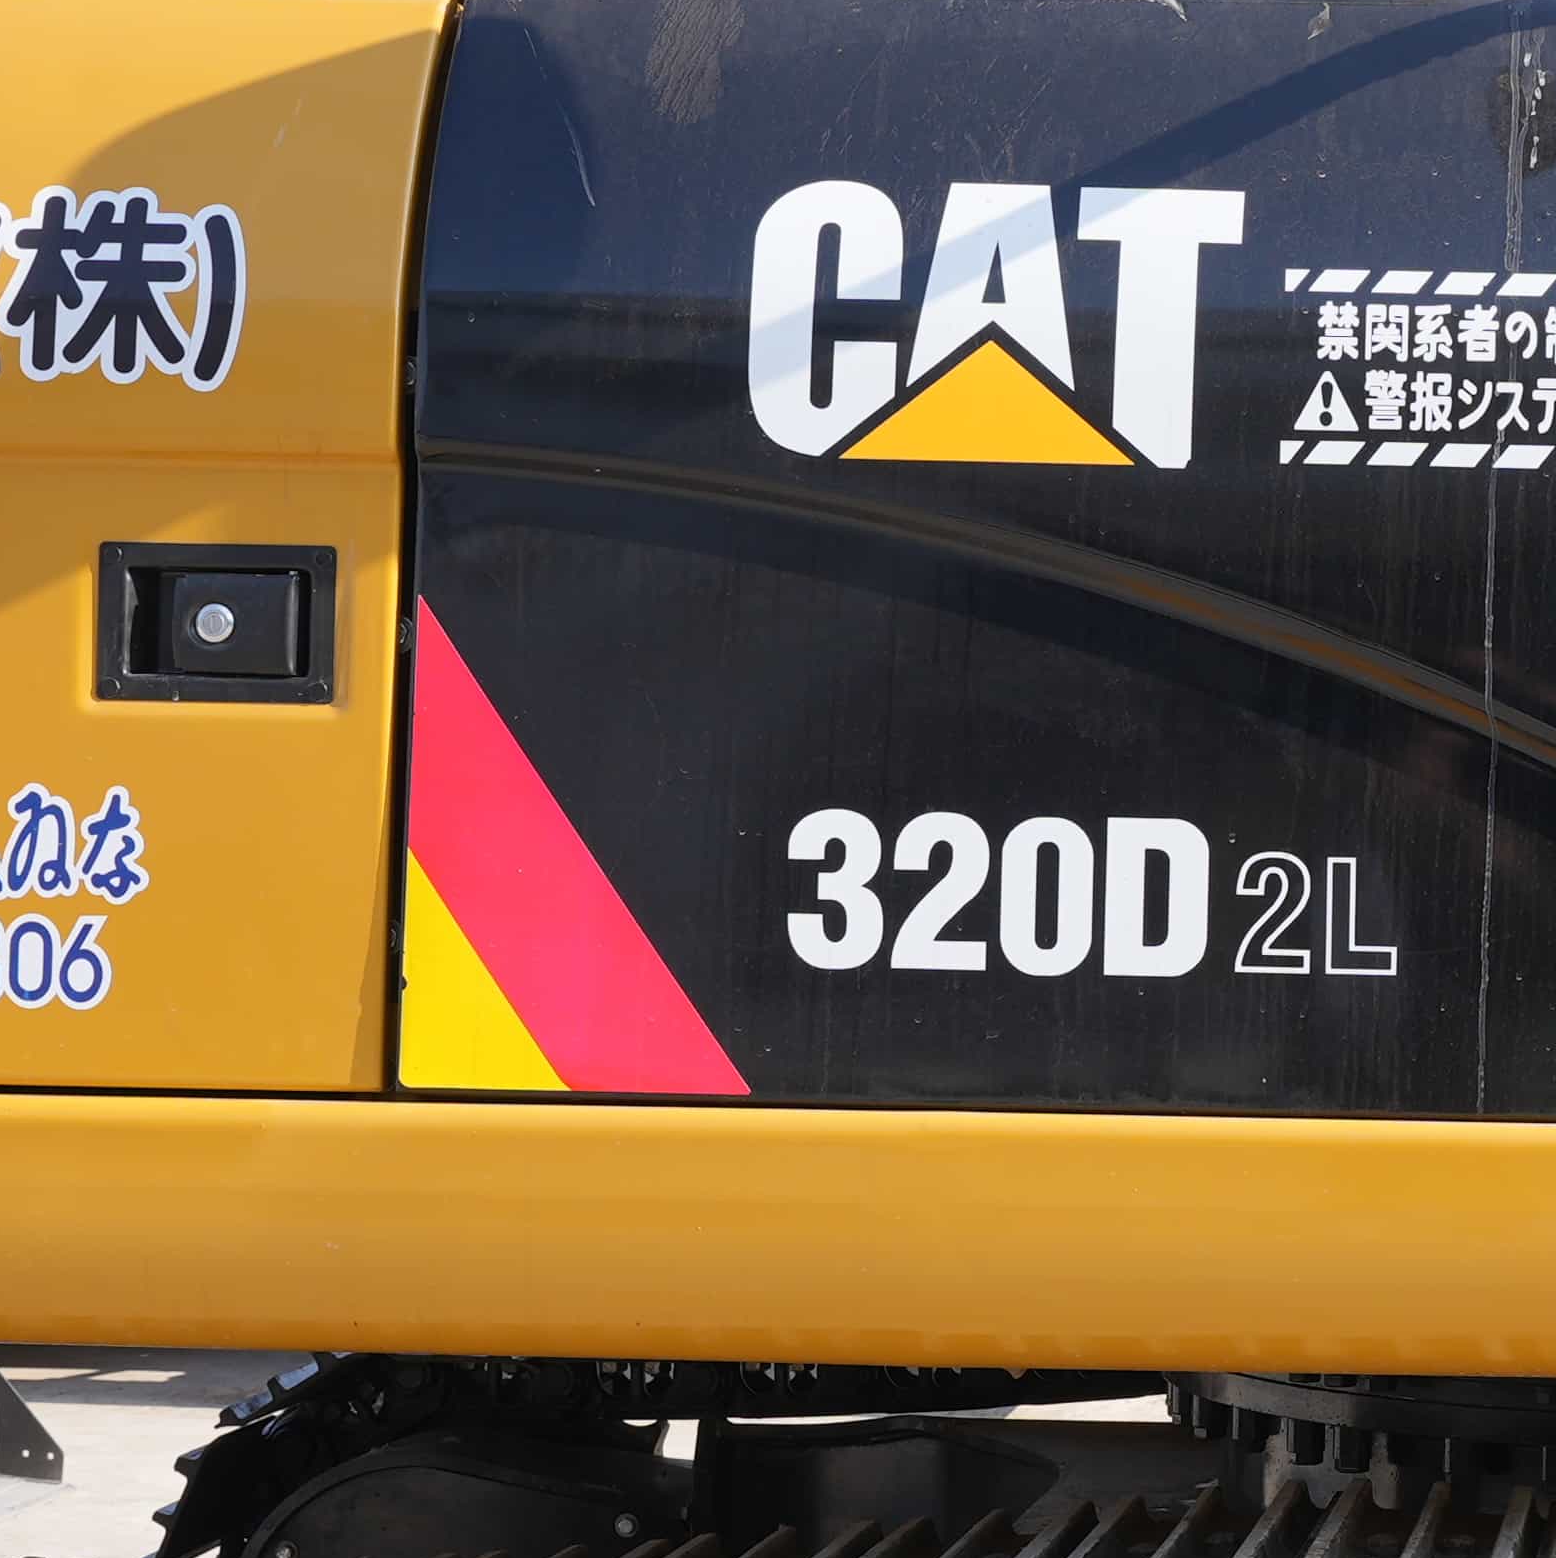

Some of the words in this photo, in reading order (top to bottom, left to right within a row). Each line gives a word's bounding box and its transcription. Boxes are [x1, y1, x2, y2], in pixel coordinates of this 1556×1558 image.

[748, 179, 1246, 469] CAT
[787, 808, 1210, 978] 320D
[1234, 851, 1398, 976] 2L
